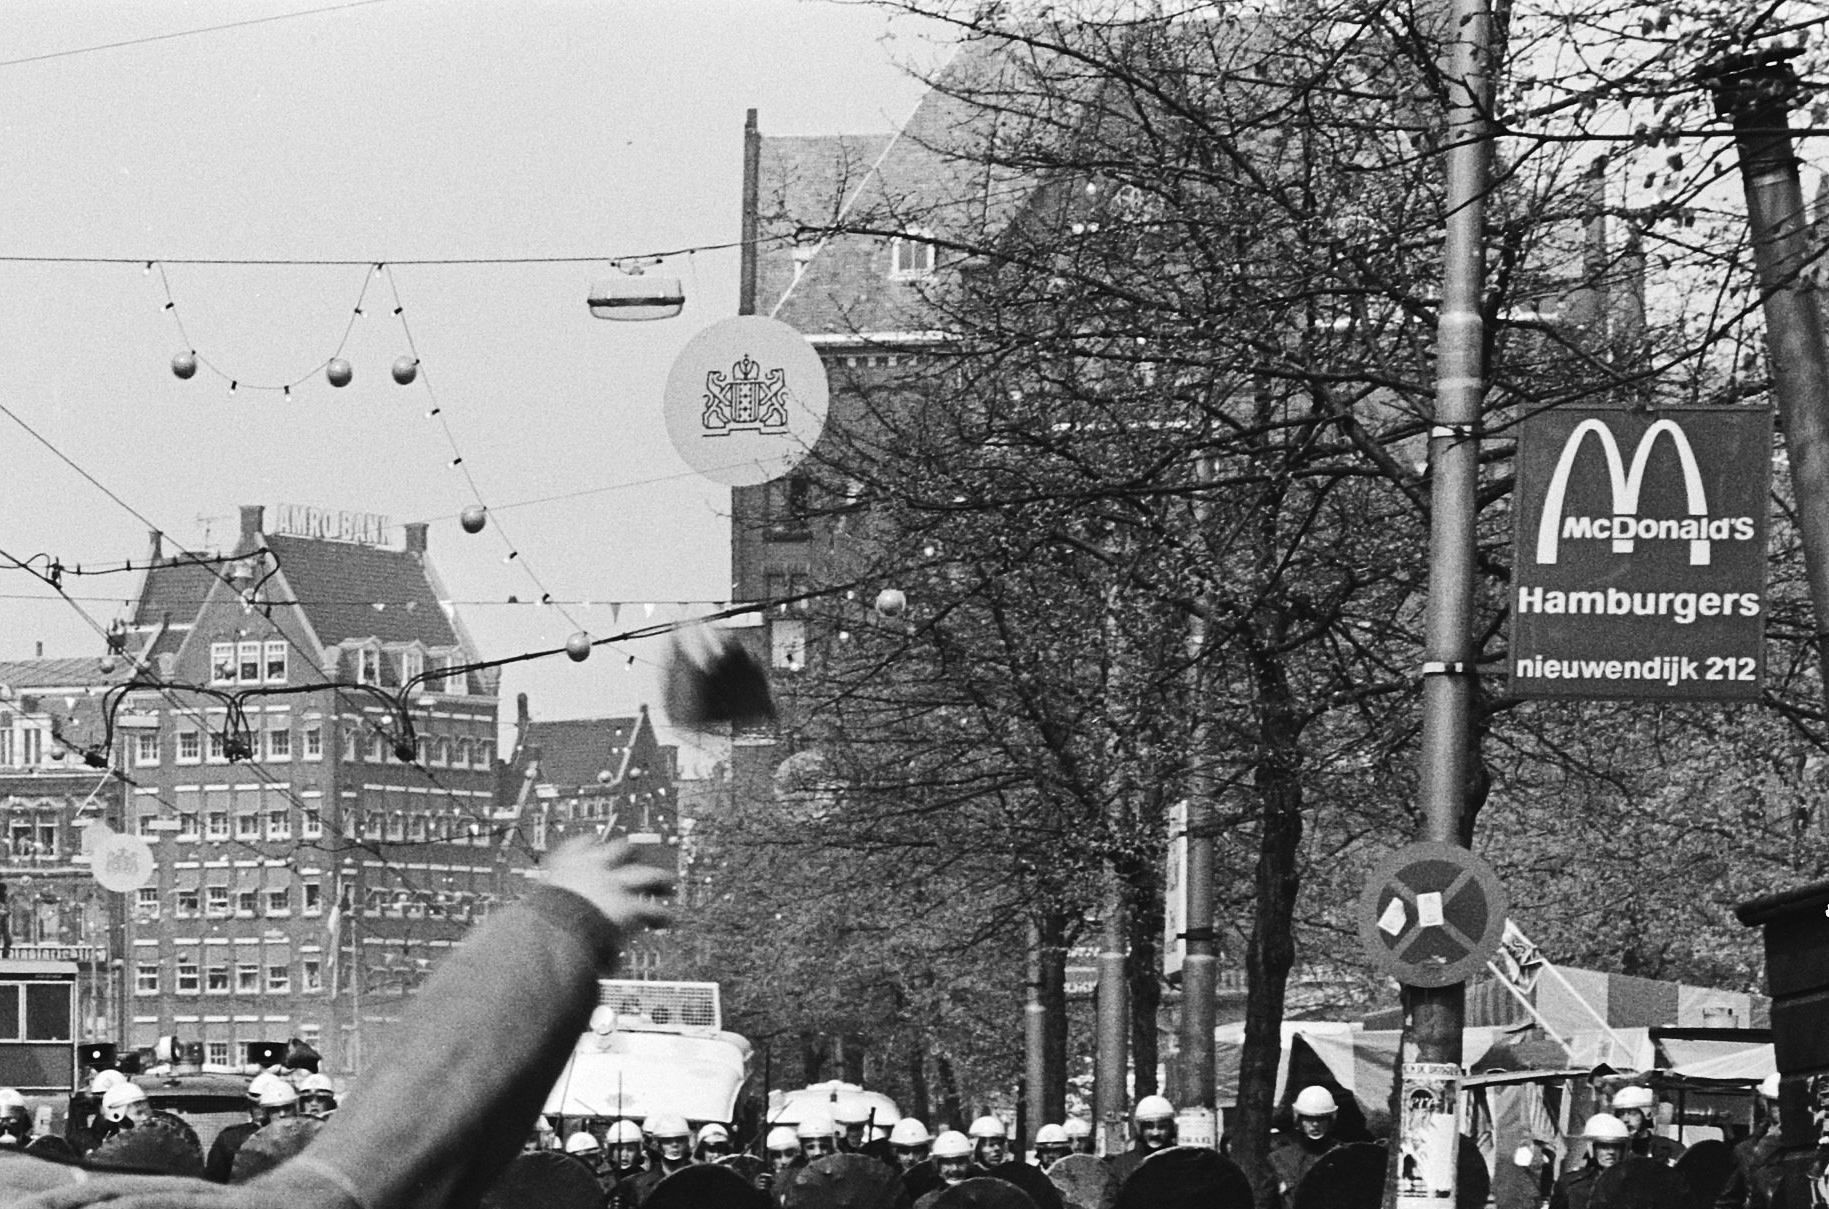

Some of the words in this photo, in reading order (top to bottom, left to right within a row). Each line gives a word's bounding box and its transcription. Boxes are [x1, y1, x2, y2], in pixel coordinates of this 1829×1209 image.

[277, 503, 338, 539] AMRO
[339, 511, 390, 546] BANK
[1561, 516, 1755, 540] McDonald's
[1518, 586, 1760, 624] Hamburgers
[1516, 655, 1699, 686] nieuwendijk
[1705, 656, 1757, 681] 212
